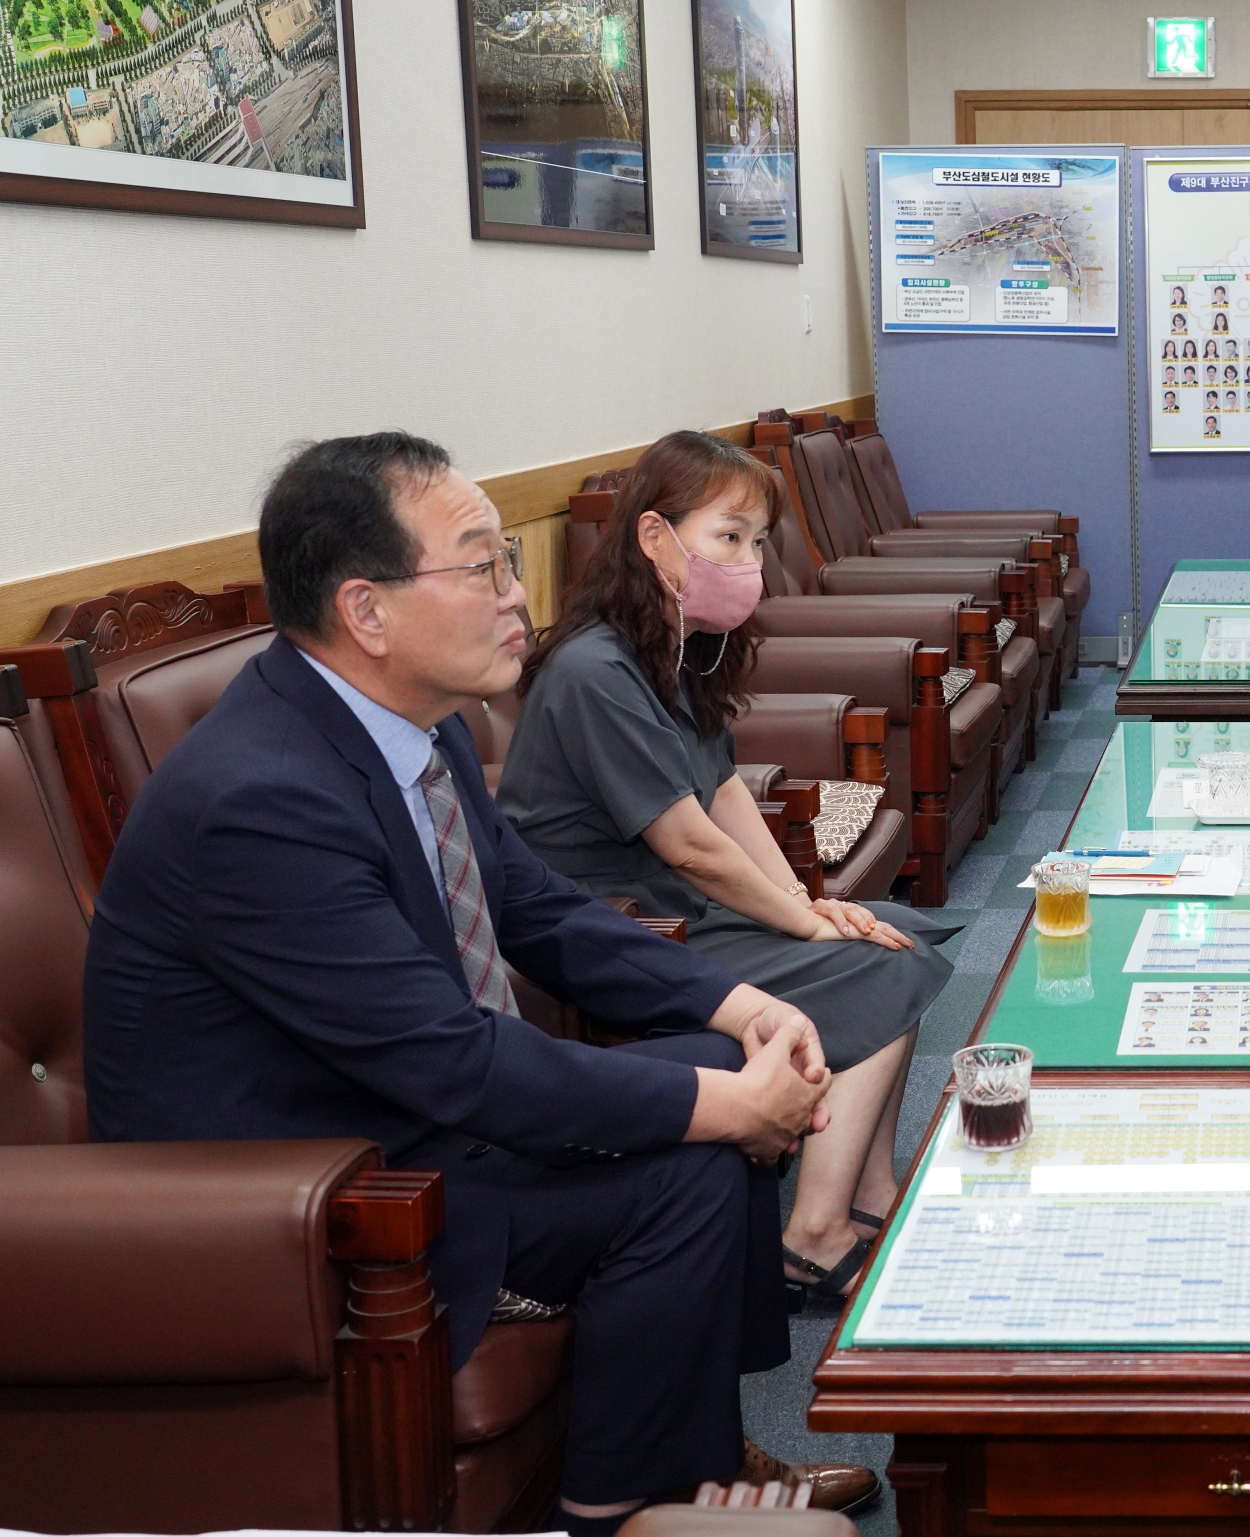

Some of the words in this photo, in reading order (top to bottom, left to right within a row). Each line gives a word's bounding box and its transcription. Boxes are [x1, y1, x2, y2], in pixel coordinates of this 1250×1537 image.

[942, 171, 1019, 183] 부산도심철도시설
[1022, 172, 1051, 183] 현황도
[1180, 177, 1206, 189] 제9대
